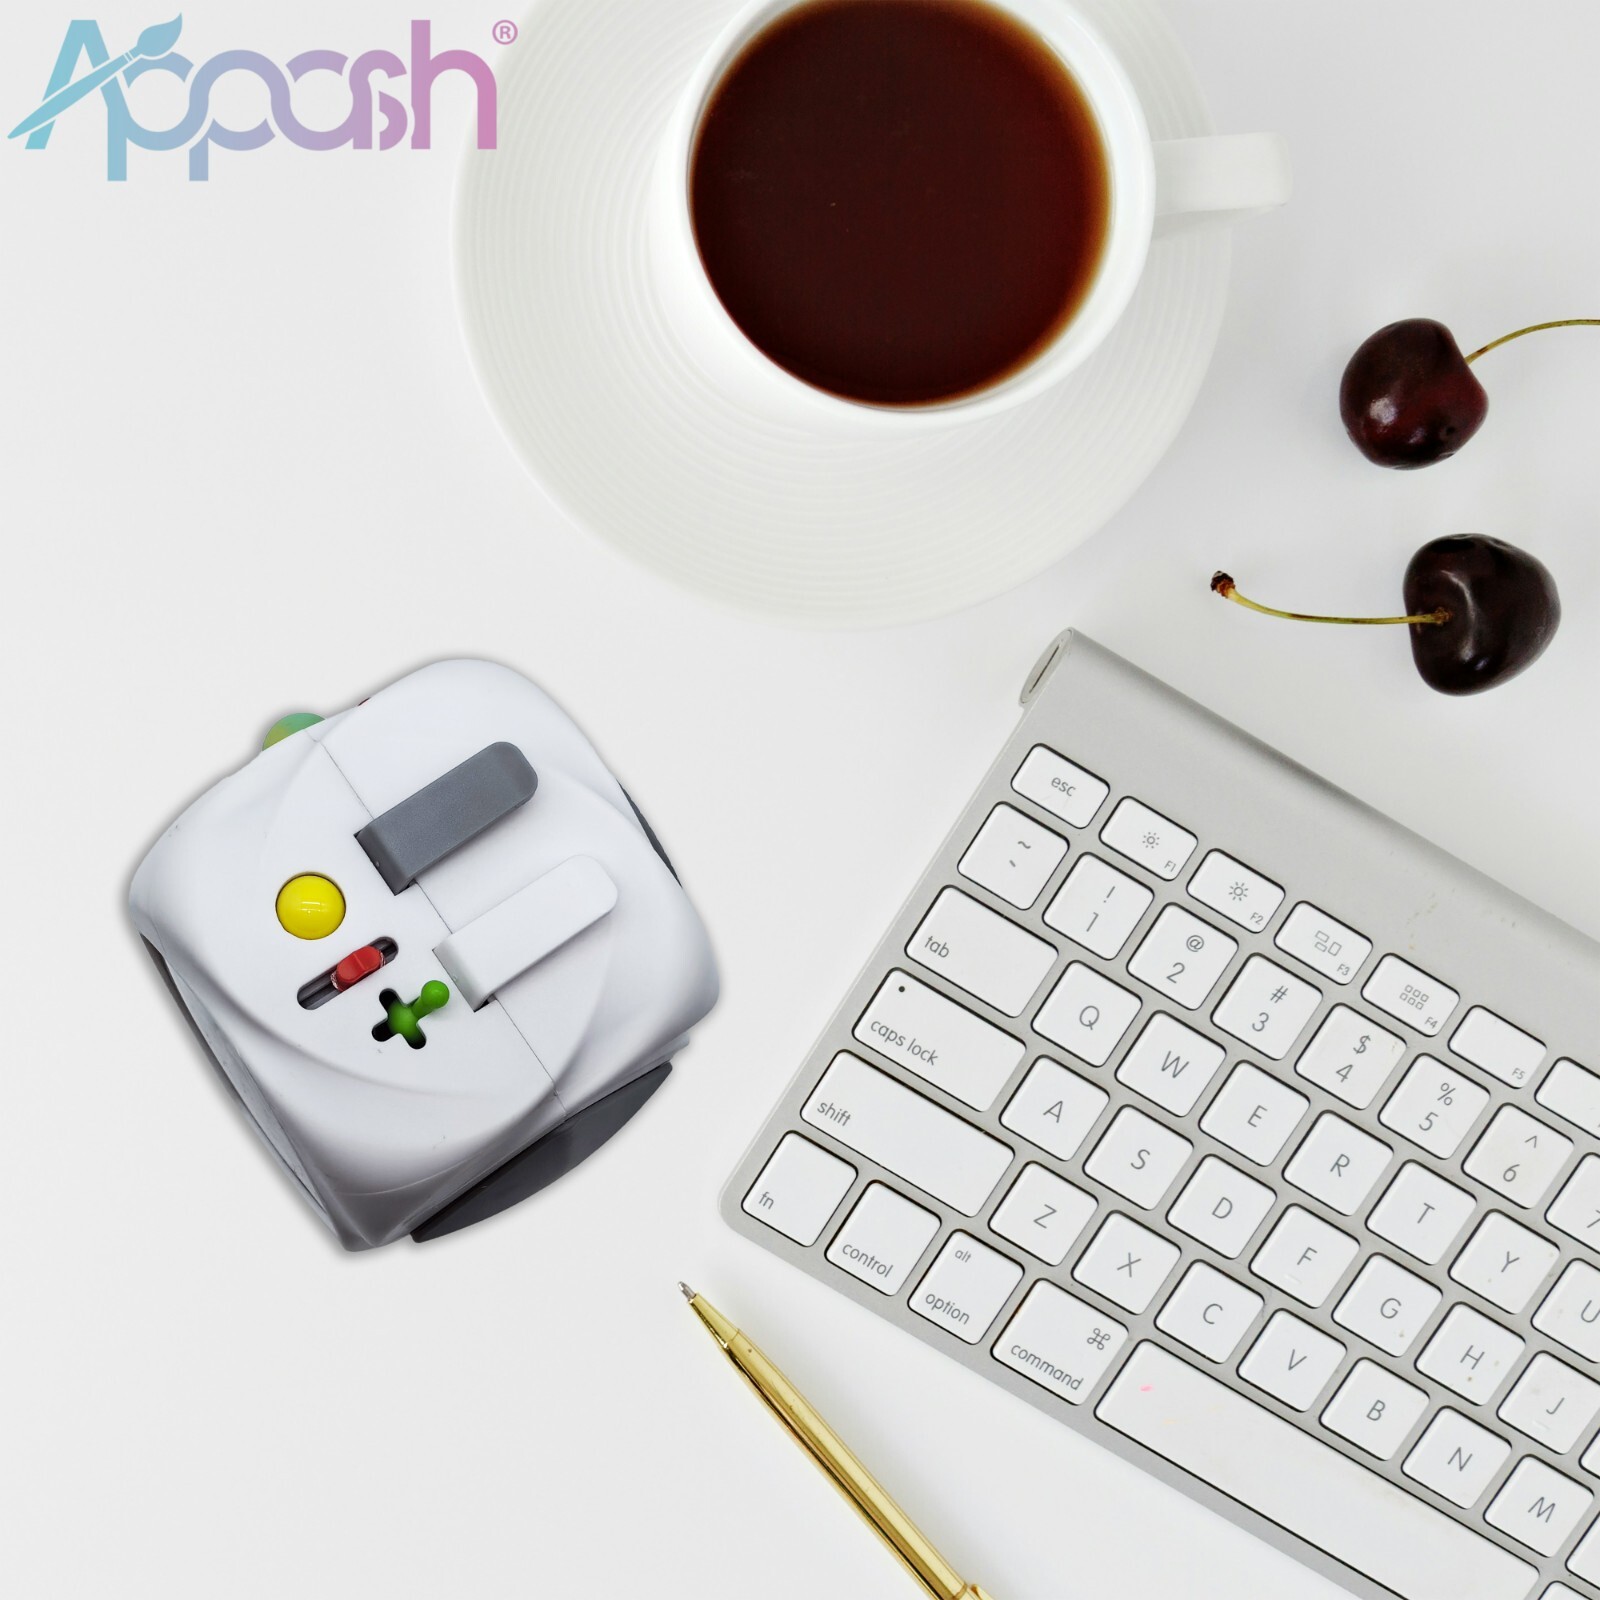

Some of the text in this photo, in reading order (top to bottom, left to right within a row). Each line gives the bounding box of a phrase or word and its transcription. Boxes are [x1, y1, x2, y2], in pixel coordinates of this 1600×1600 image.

[1050, 776, 1077, 797] esc
[1164, 860, 1177, 873] F1
[1104, 886, 1115, 903] !
[1086, 912, 1099, 932] 1
[1250, 911, 1265, 926] F2
[925, 936, 949, 958] tab
[1186, 935, 1204, 952] @
[1166, 962, 1185, 983] 2
[1337, 963, 1350, 977] F3
[1270, 986, 1288, 1003] #
[1079, 1005, 1100, 1030] Q
[1252, 1012, 1269, 1032] 3
[1424, 1016, 1439, 1030] F4
[870, 1019, 939, 1066] caps lock
[1353, 1035, 1371, 1054] $
[1161, 1051, 1189, 1078] W
[1336, 1064, 1353, 1082] 4
[1512, 1067, 1526, 1081] F5
[1437, 1083, 1456, 1106] %
[816, 1101, 852, 1127] shift
[1043, 1101, 1063, 1123] A
[1248, 1105, 1267, 1127] E
[1419, 1112, 1438, 1131] 5
[1131, 1149, 1150, 1170] S
[1330, 1154, 1350, 1177] R
[1503, 1164, 1520, 1182] 6
[758, 1191, 775, 1210] fn
[1212, 1197, 1233, 1219] D
[1033, 1204, 1057, 1229] Z
[1417, 1203, 1435, 1224] T
[841, 1243, 894, 1279] control
[954, 1249, 972, 1264] alt
[1117, 1253, 1141, 1277] X
[1297, 1247, 1317, 1265] F
[1501, 1251, 1520, 1272] Y
[924, 1293, 971, 1325] option
[1203, 1303, 1223, 1324] C
[1380, 1298, 1401, 1319] G
[1581, 1300, 1600, 1323] U
[1010, 1344, 1084, 1392] command
[1288, 1349, 1307, 1371] V
[1460, 1345, 1485, 1370] H
[1366, 1400, 1385, 1421] B
[1546, 1398, 1564, 1414] J
[1448, 1447, 1473, 1472] N
[1528, 1497, 1556, 1523] M
